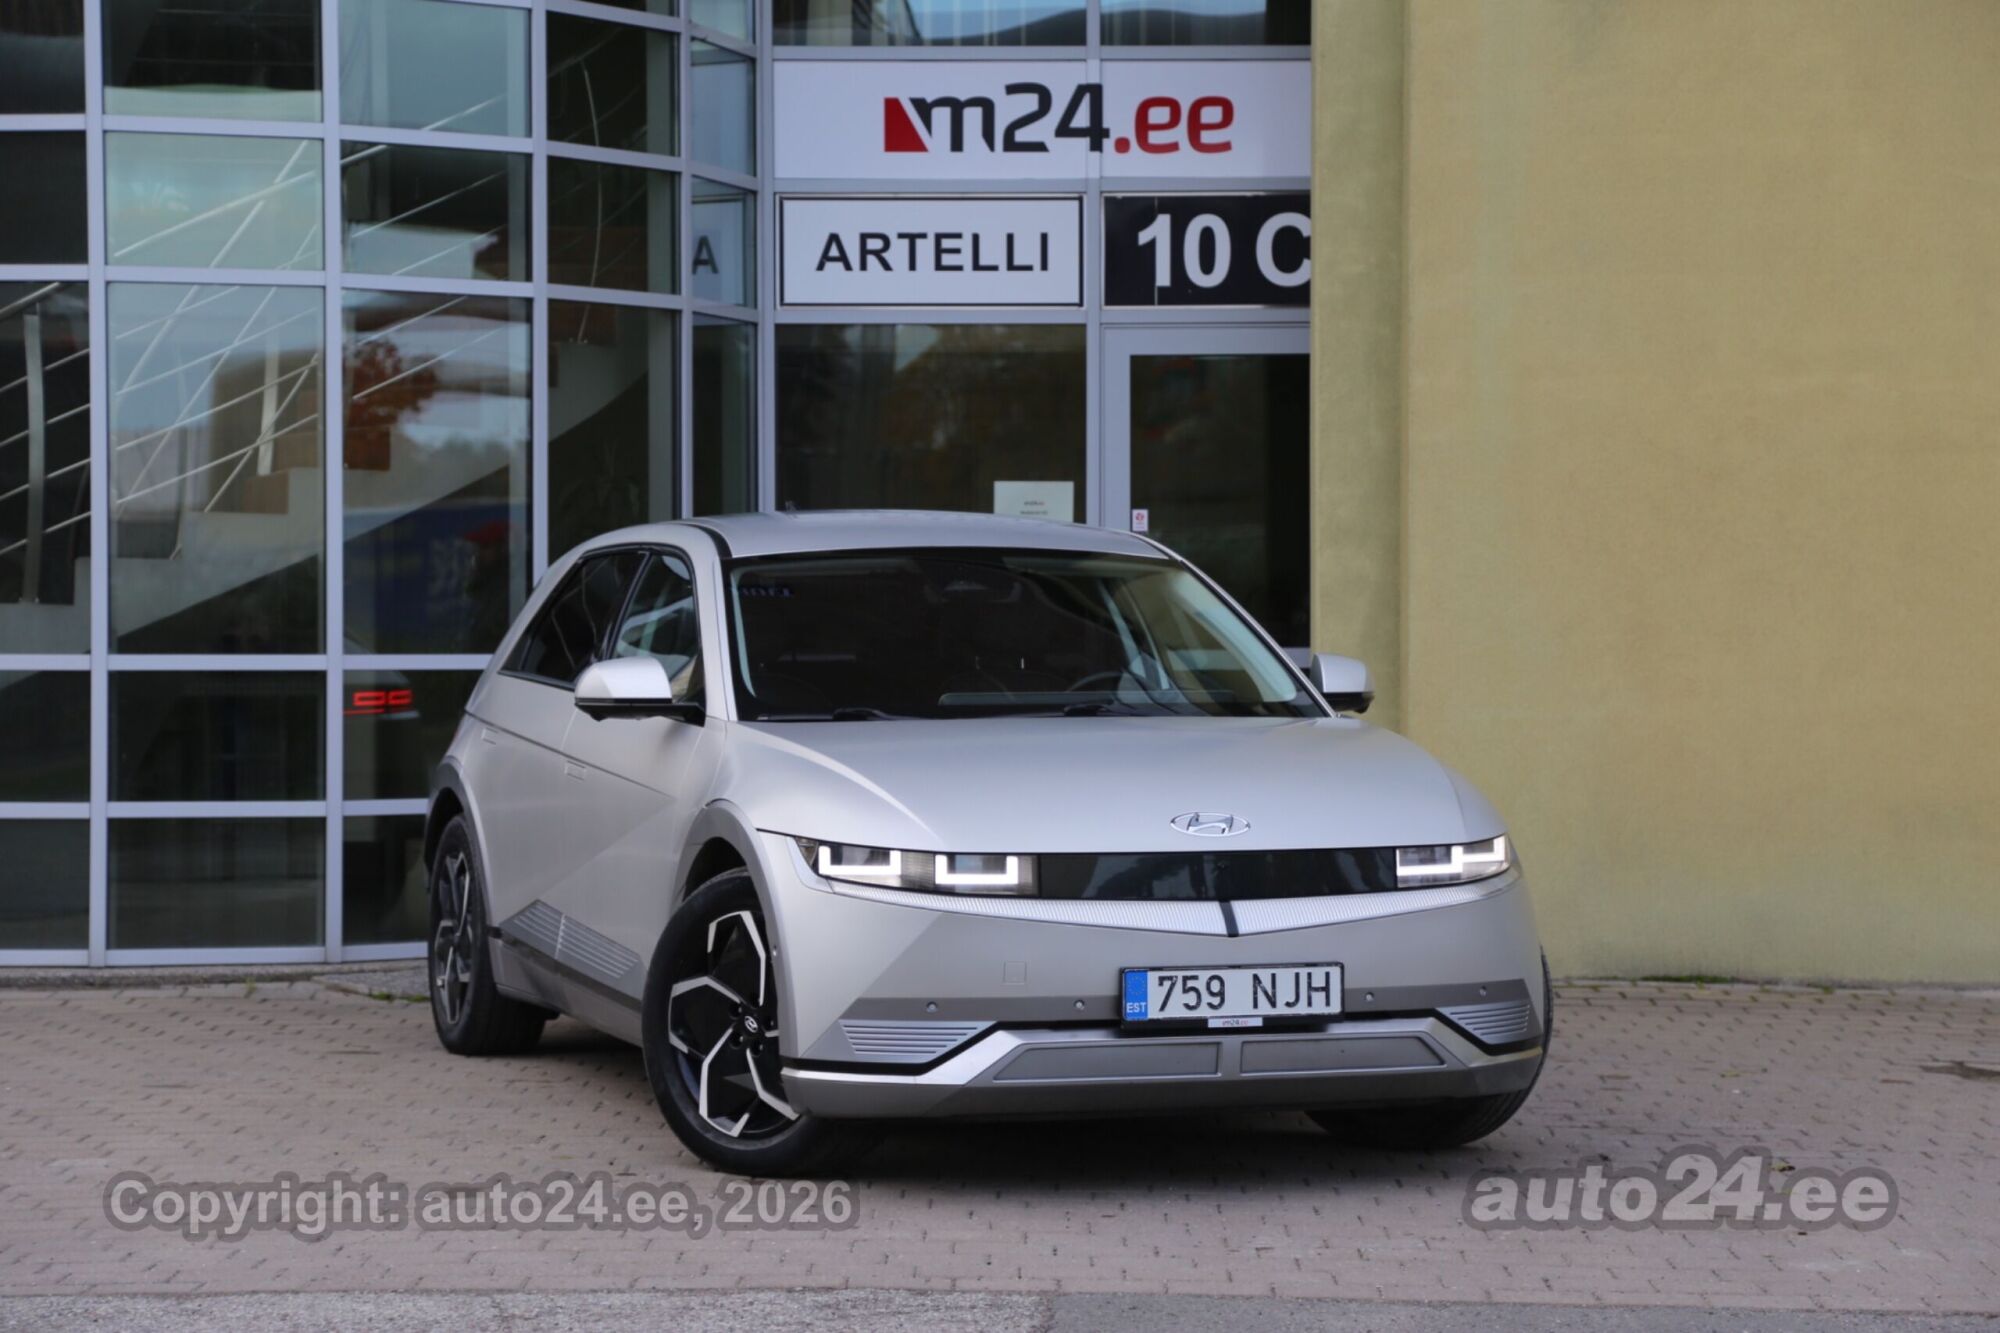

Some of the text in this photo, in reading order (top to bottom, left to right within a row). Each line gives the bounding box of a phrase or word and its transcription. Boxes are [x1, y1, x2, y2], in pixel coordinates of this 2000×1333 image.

[907, 82, 1235, 155] m24.ee
[815, 232, 1050, 272] ARTELLI
[1137, 213, 1232, 287] 10
[1126, 1002, 1147, 1013] EST
[1158, 971, 1331, 1012] 759 NJH
